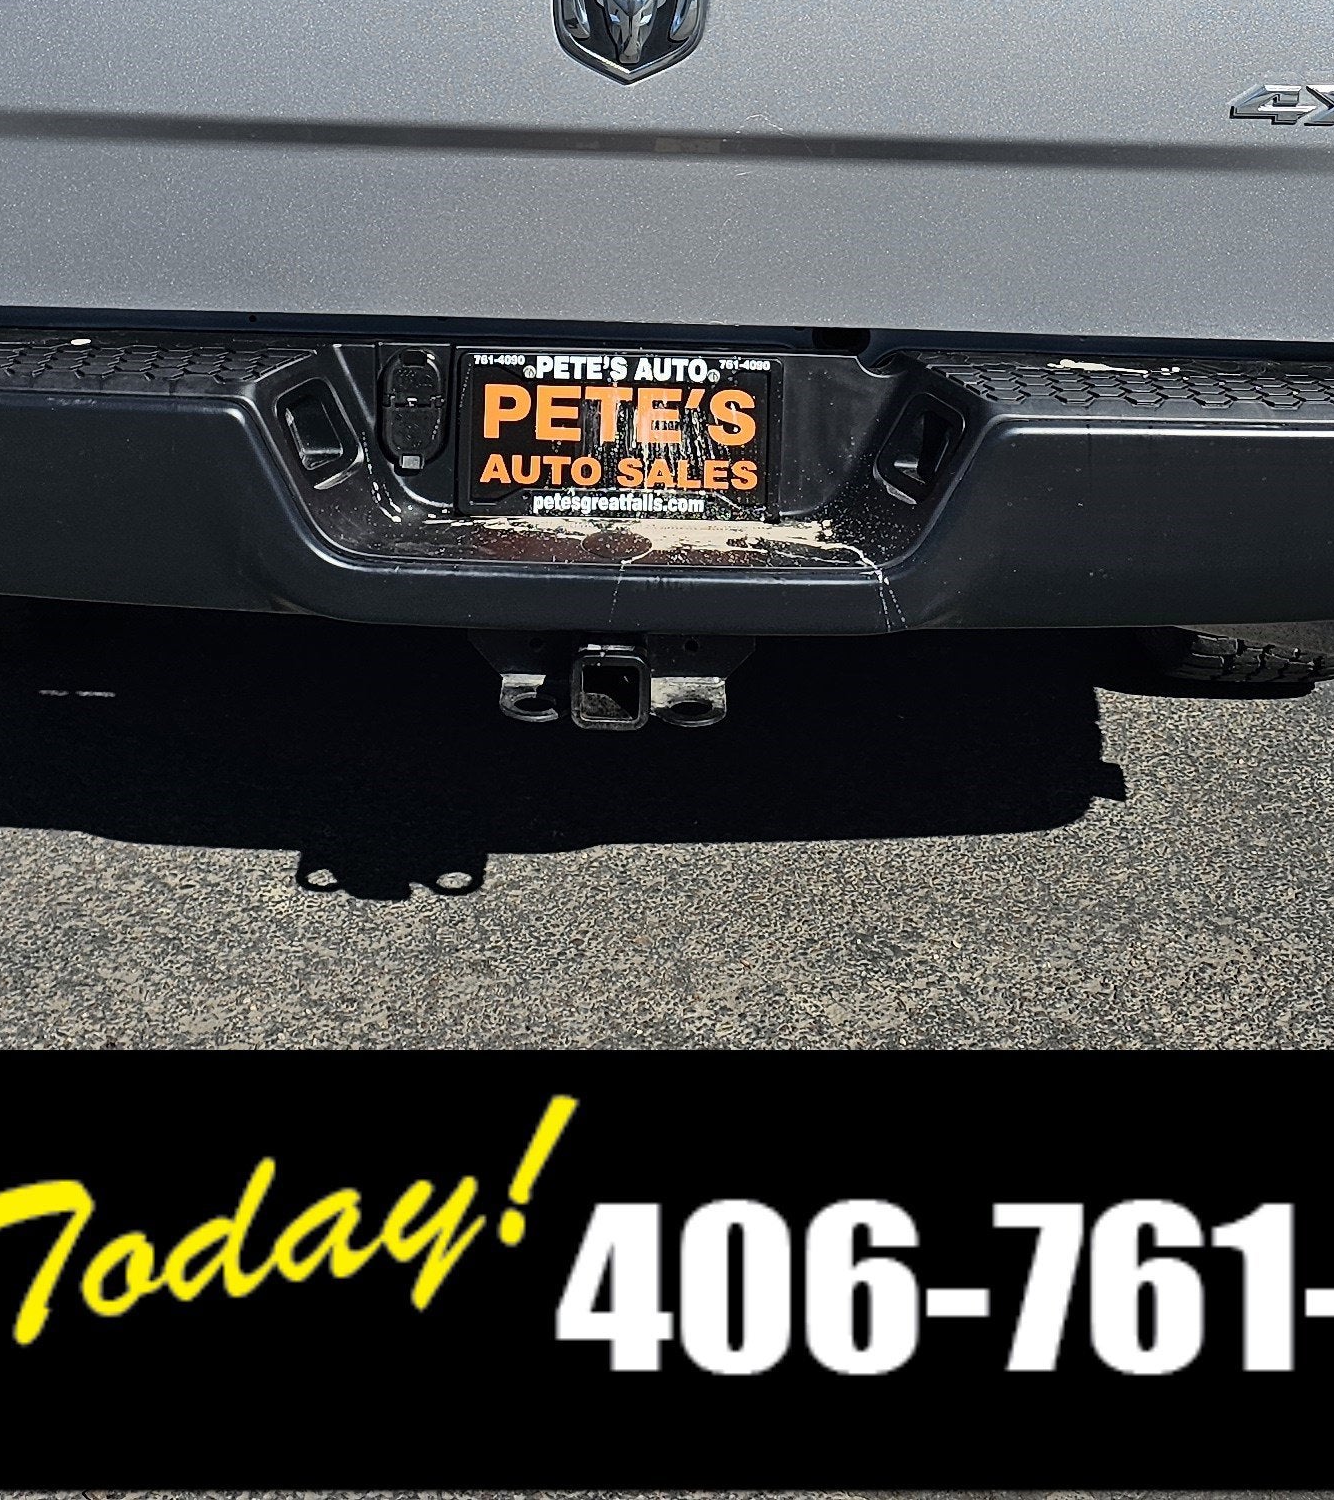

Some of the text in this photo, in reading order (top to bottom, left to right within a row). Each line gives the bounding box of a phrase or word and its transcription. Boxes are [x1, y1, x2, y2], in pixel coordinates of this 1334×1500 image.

[473, 354, 526, 366] 761-4090
[536, 354, 709, 383] PETE'S AUTO
[483, 383, 757, 446] PETE'S
[479, 453, 759, 491] AUTO SALES
[532, 490, 705, 514] petesgreatfalls.com
